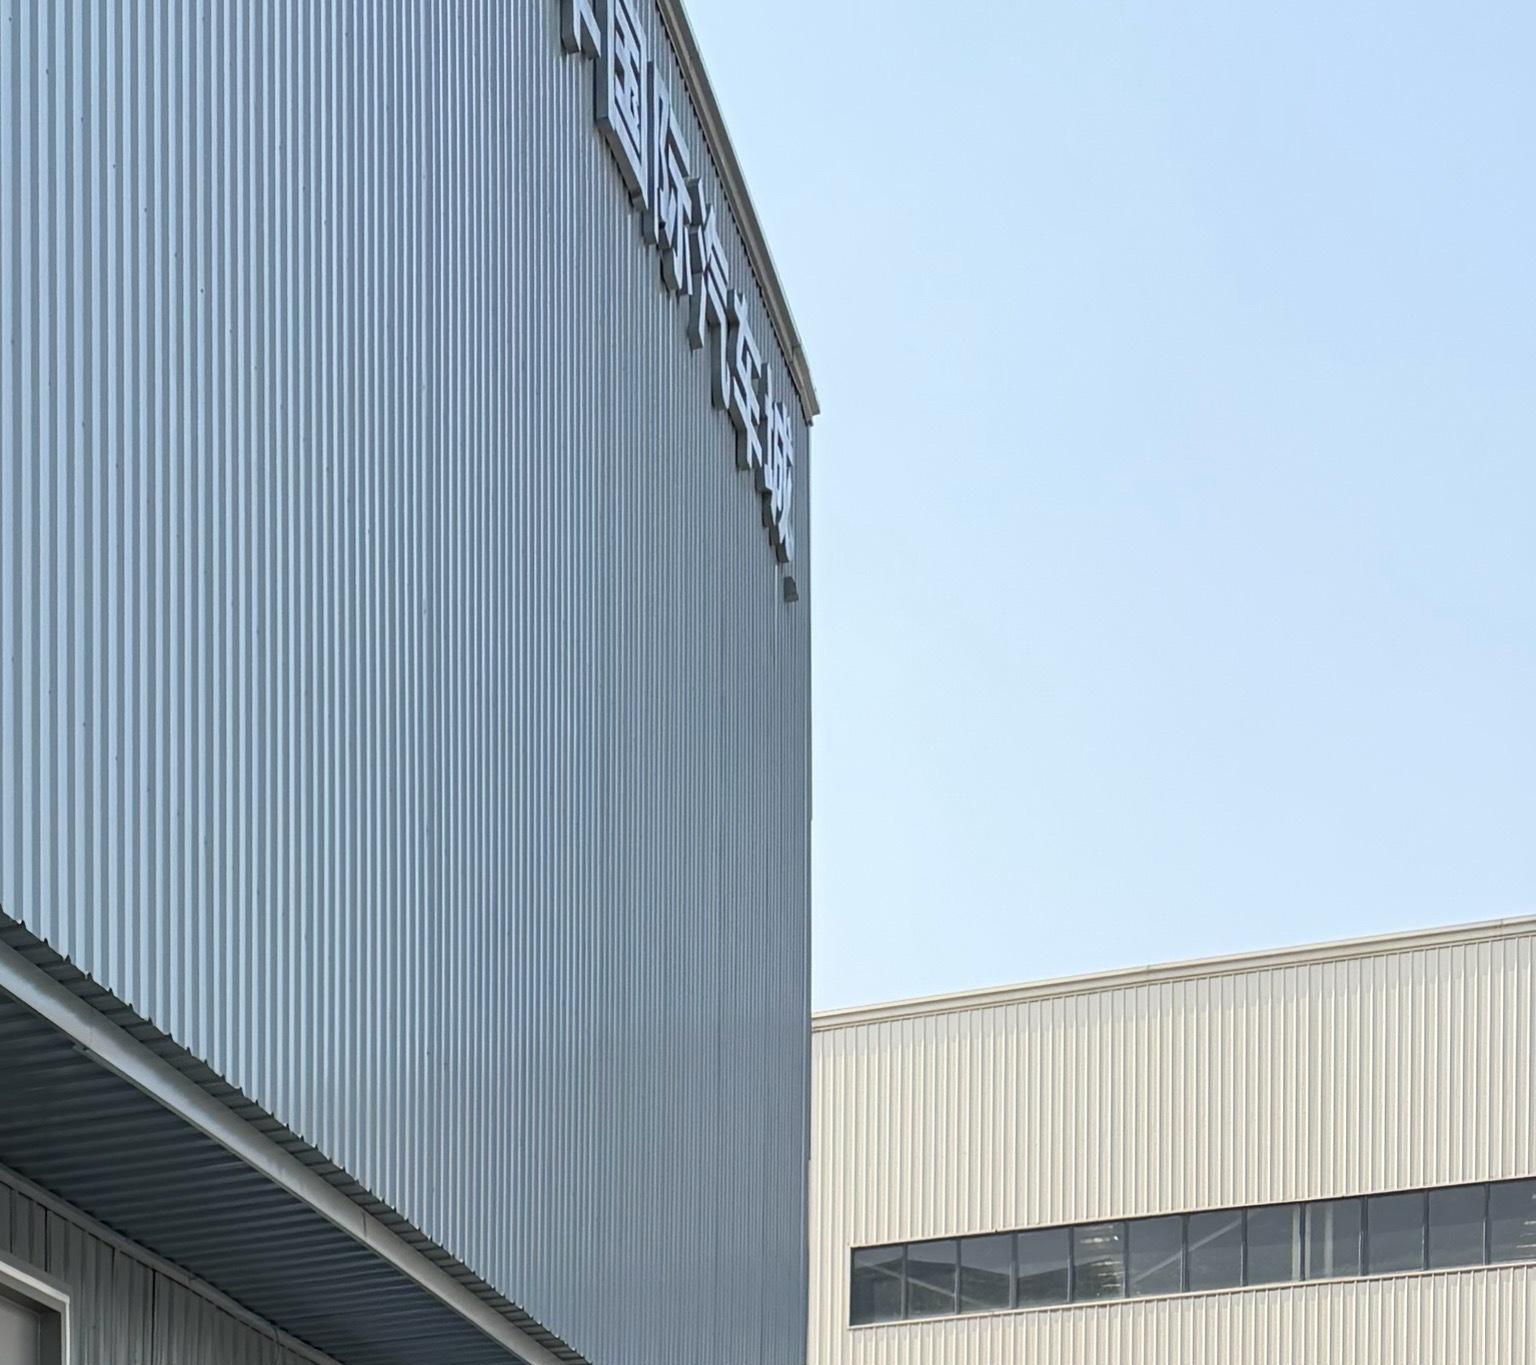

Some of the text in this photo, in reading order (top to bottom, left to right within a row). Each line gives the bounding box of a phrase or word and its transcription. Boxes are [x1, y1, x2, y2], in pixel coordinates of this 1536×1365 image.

[561, 0, 794, 562] 国际汽车城
